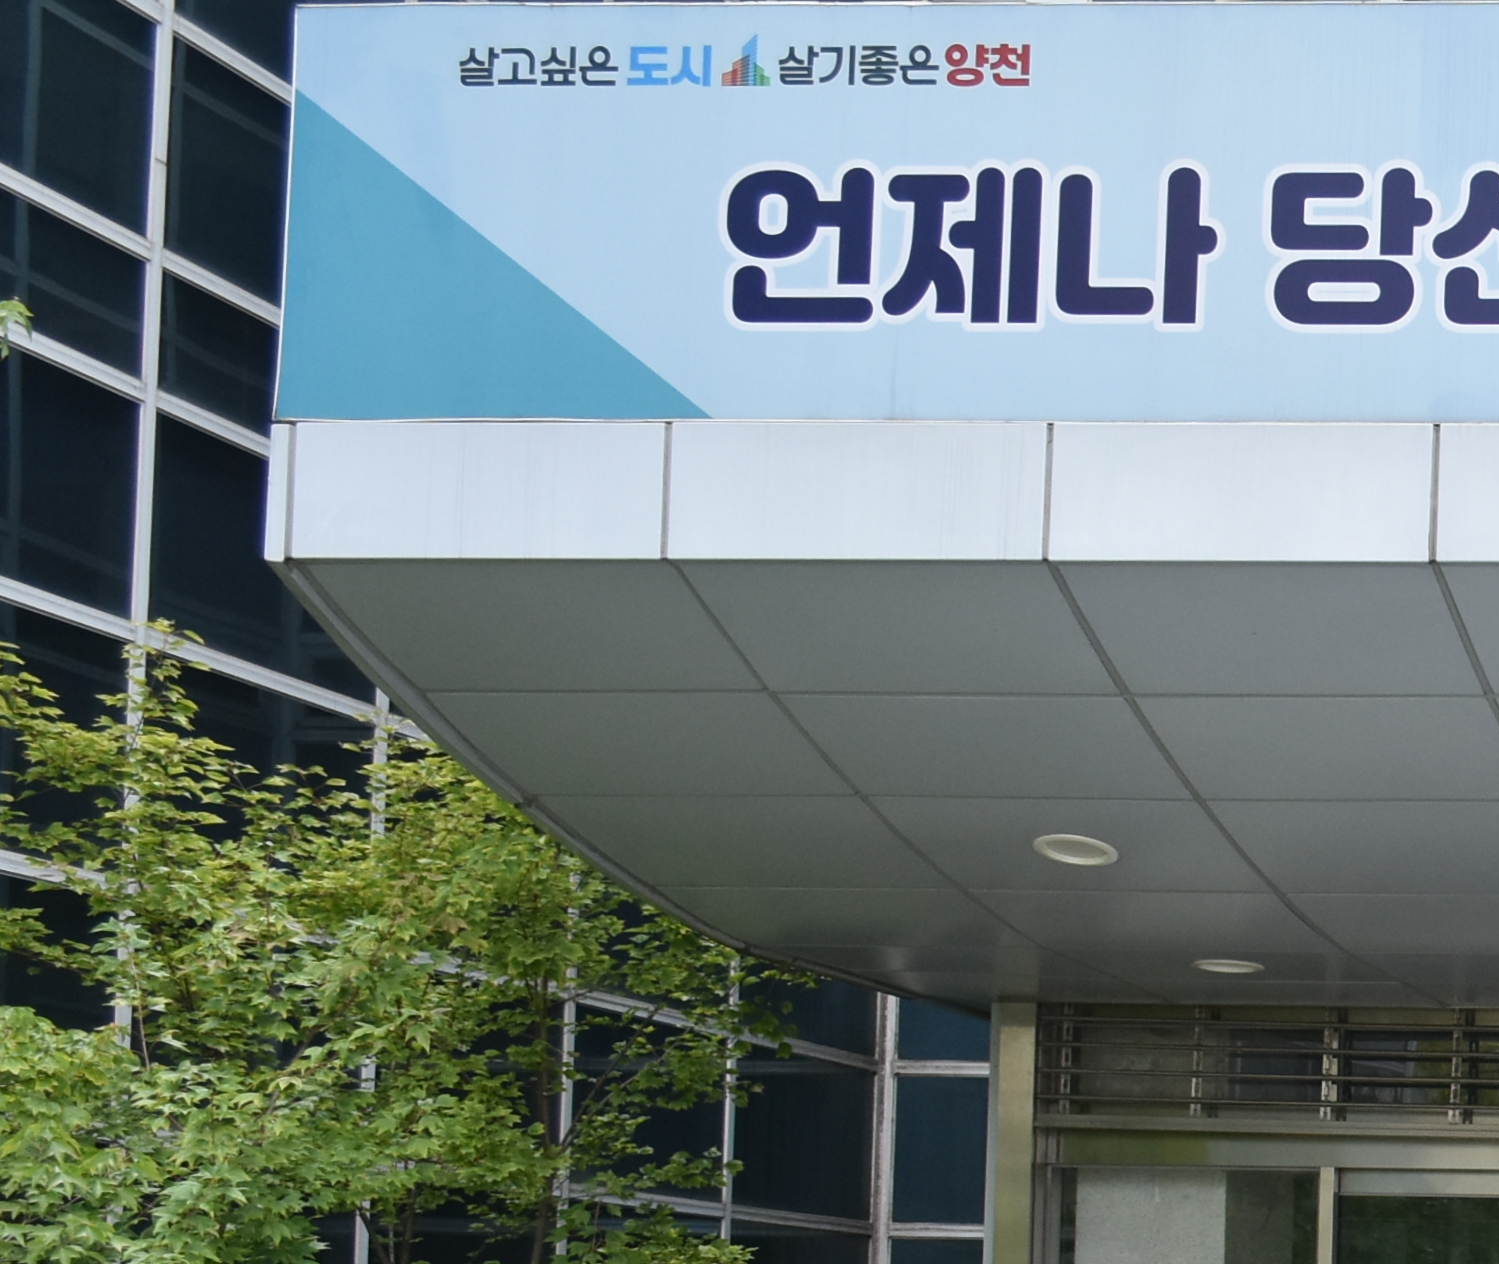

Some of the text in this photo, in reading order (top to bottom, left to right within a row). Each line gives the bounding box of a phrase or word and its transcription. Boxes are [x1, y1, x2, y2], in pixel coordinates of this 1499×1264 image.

[459, 43, 1032, 88] 살고싶은 도시 살기좋은 양천
[724, 165, 1219, 326] 언제나
